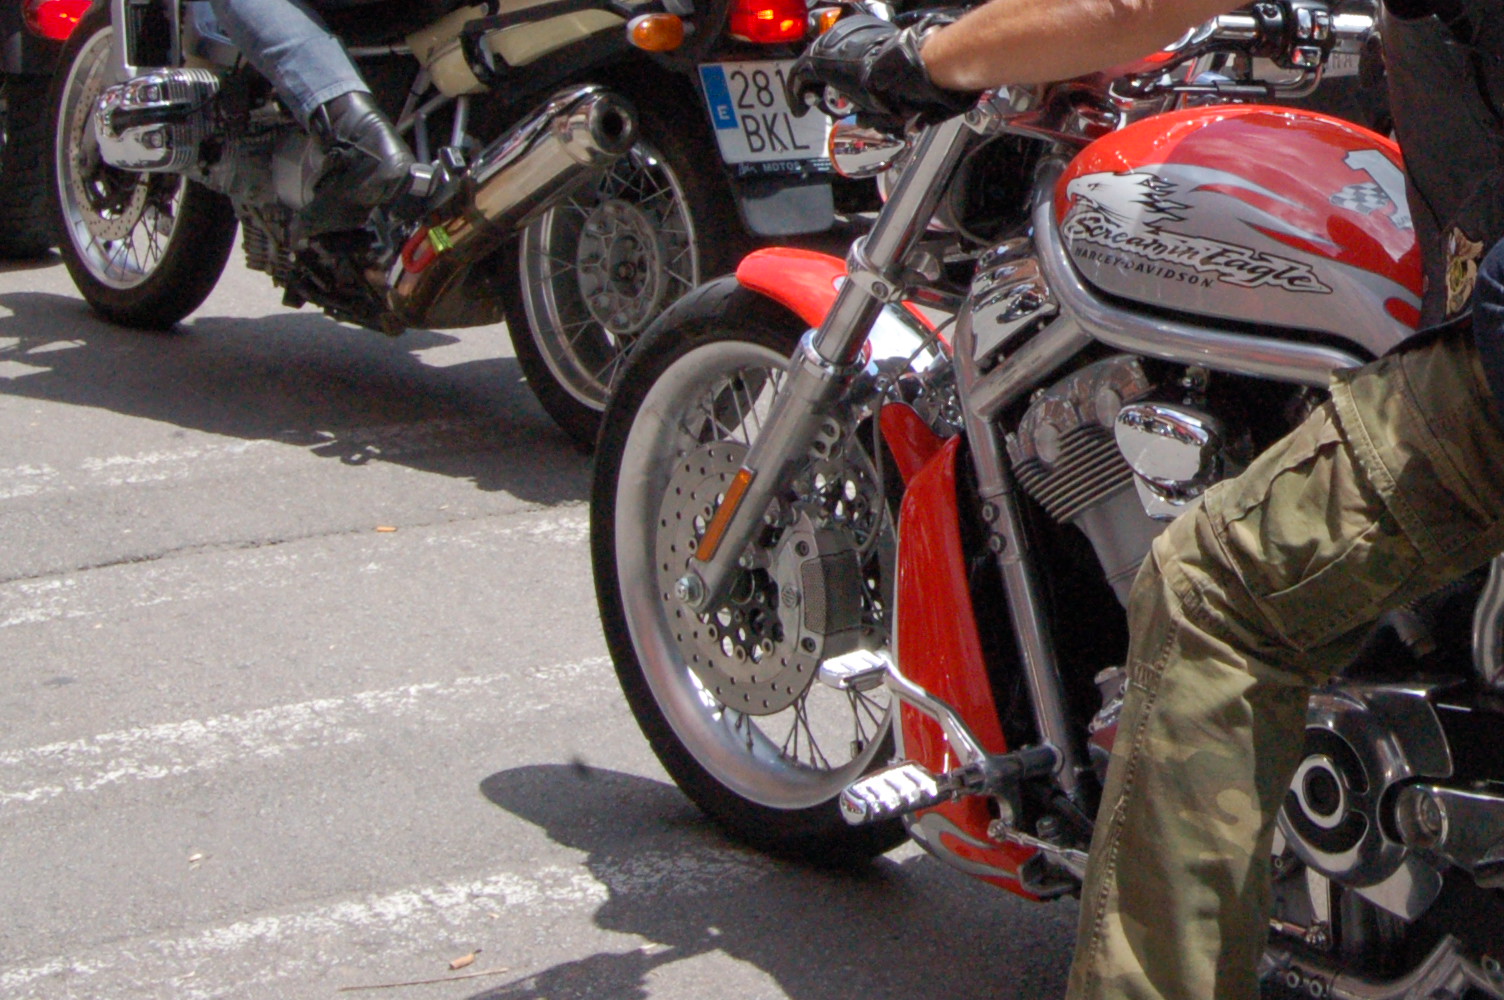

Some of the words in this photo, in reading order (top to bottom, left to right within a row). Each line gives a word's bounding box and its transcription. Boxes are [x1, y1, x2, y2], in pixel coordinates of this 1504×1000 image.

[730, 69, 791, 110] 281
[717, 105, 731, 120] E
[741, 112, 810, 153] BKL
[1074, 246, 1214, 287] HARLEY-DAVIDSON
[1200, 247, 1321, 289] Eagle
